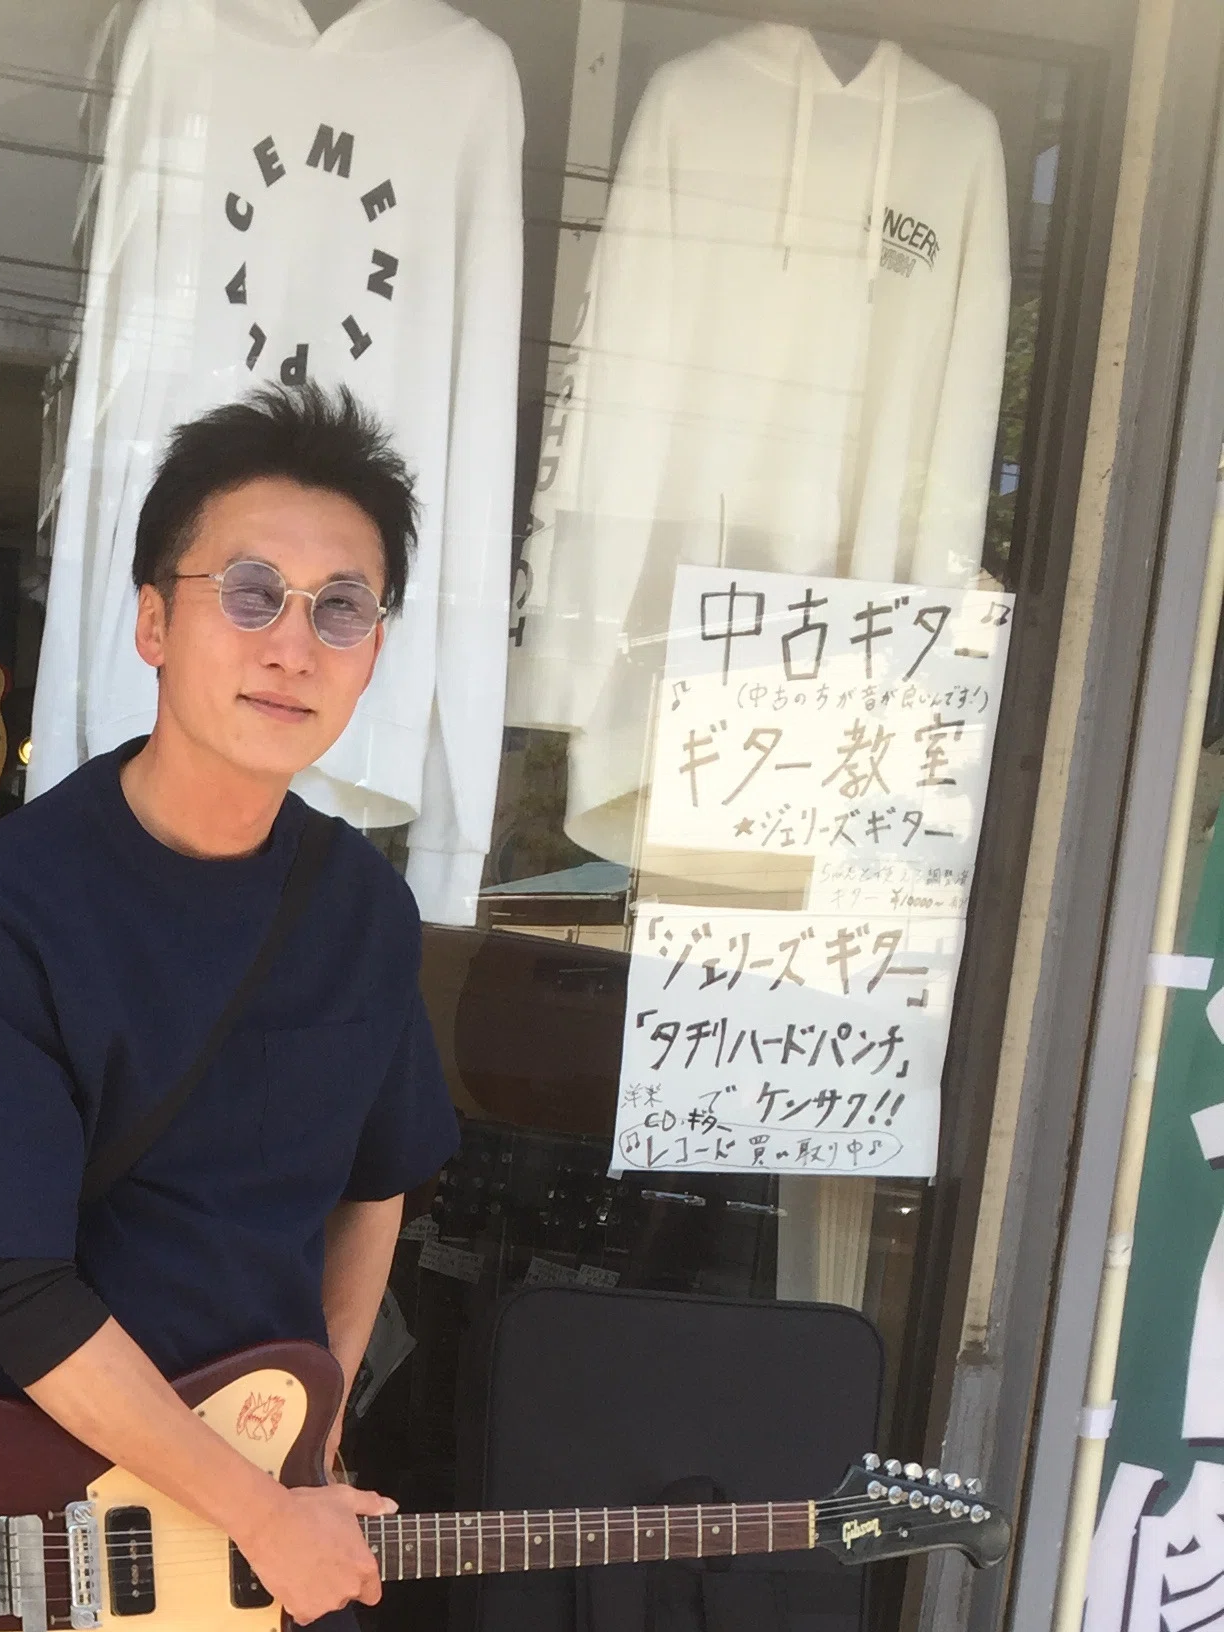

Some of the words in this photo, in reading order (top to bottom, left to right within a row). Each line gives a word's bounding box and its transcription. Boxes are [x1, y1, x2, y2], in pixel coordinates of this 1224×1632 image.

[864, 206, 940, 267] NCER
[701, 581, 989, 686] 中古ギター
[678, 712, 965, 808] ギター教室
